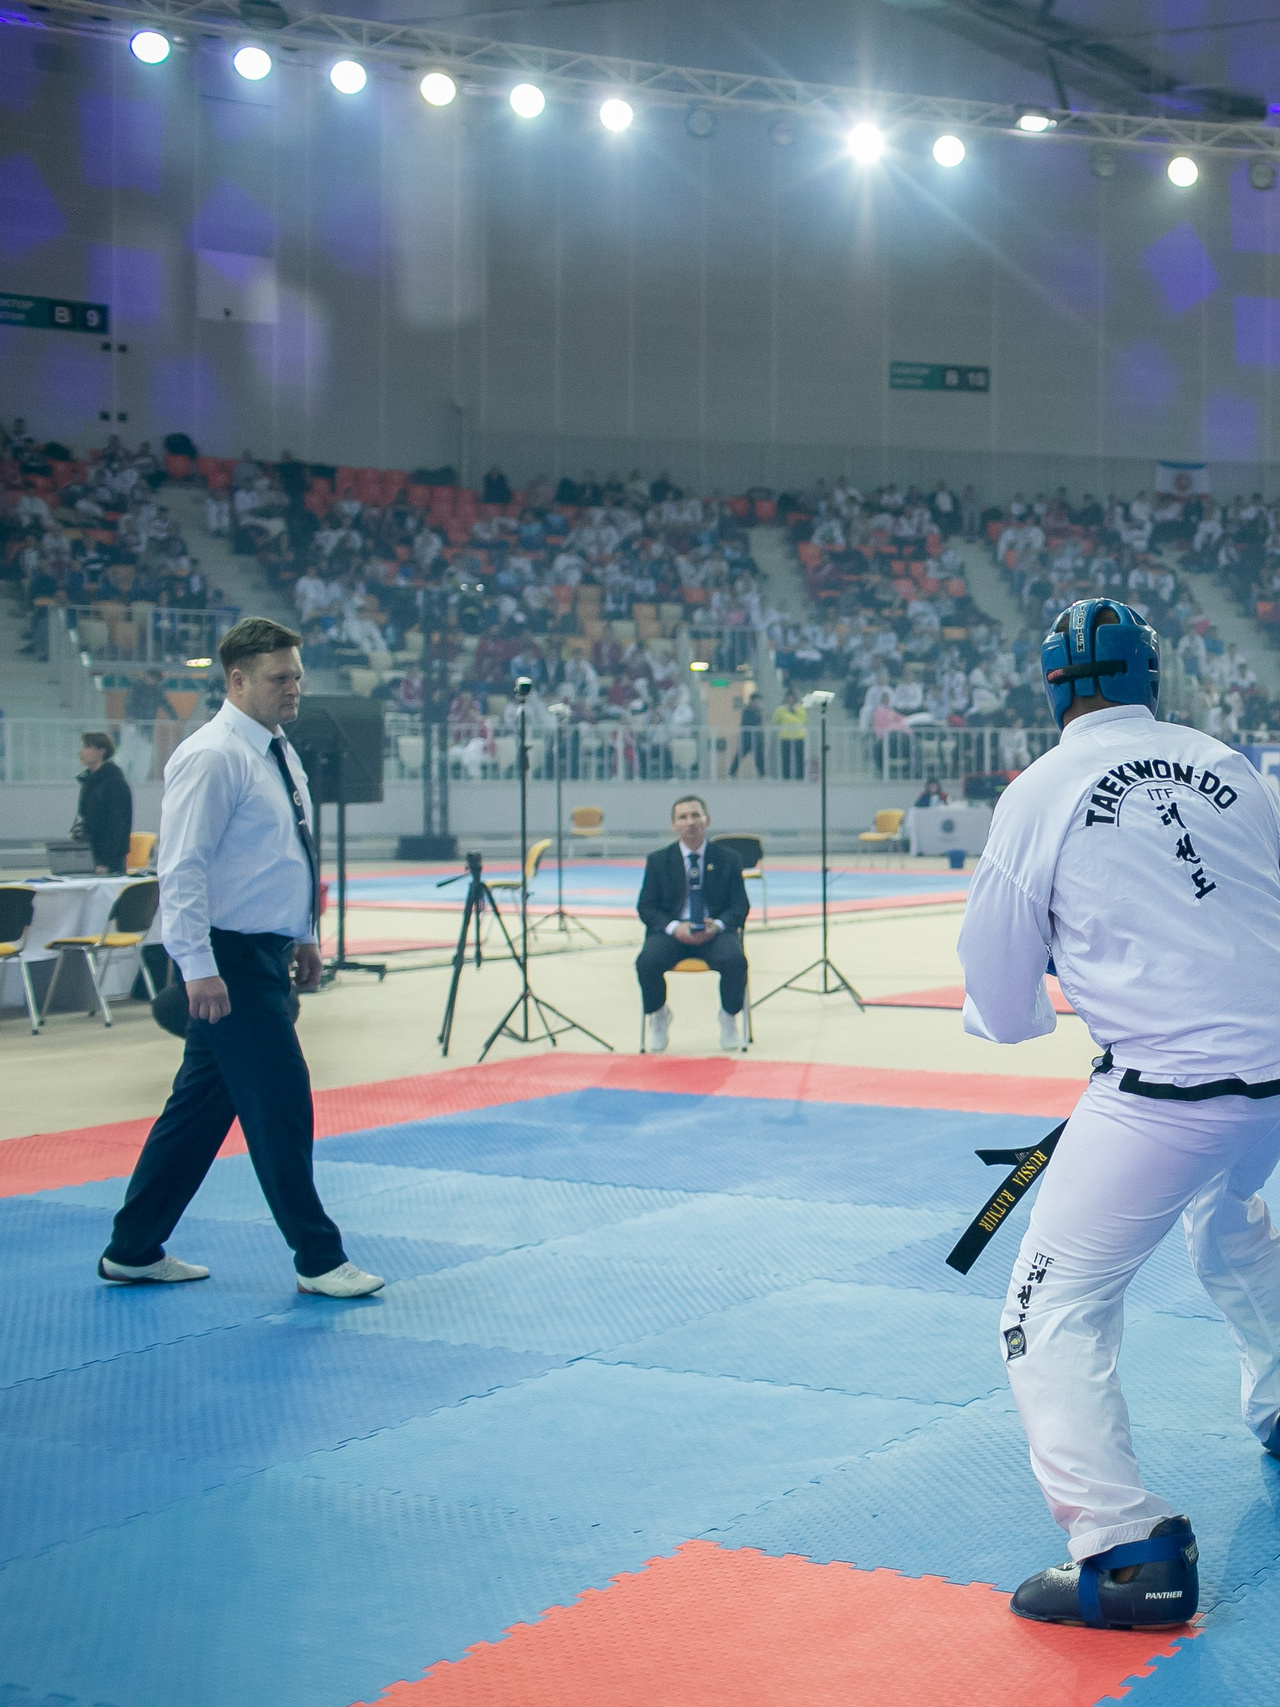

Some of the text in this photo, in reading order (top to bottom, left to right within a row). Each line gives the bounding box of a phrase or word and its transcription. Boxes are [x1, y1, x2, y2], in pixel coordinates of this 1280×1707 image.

[86, 309, 100, 327] 9
[1085, 759, 1238, 827] TAEKWON-DO
[1147, 788, 1174, 801] ITF
[1012, 1150, 1048, 1187] RUSSIA
[978, 1189, 1016, 1232] RATMIR
[1034, 1252, 1055, 1267] ITF
[1145, 1590, 1183, 1600] PANTHER
